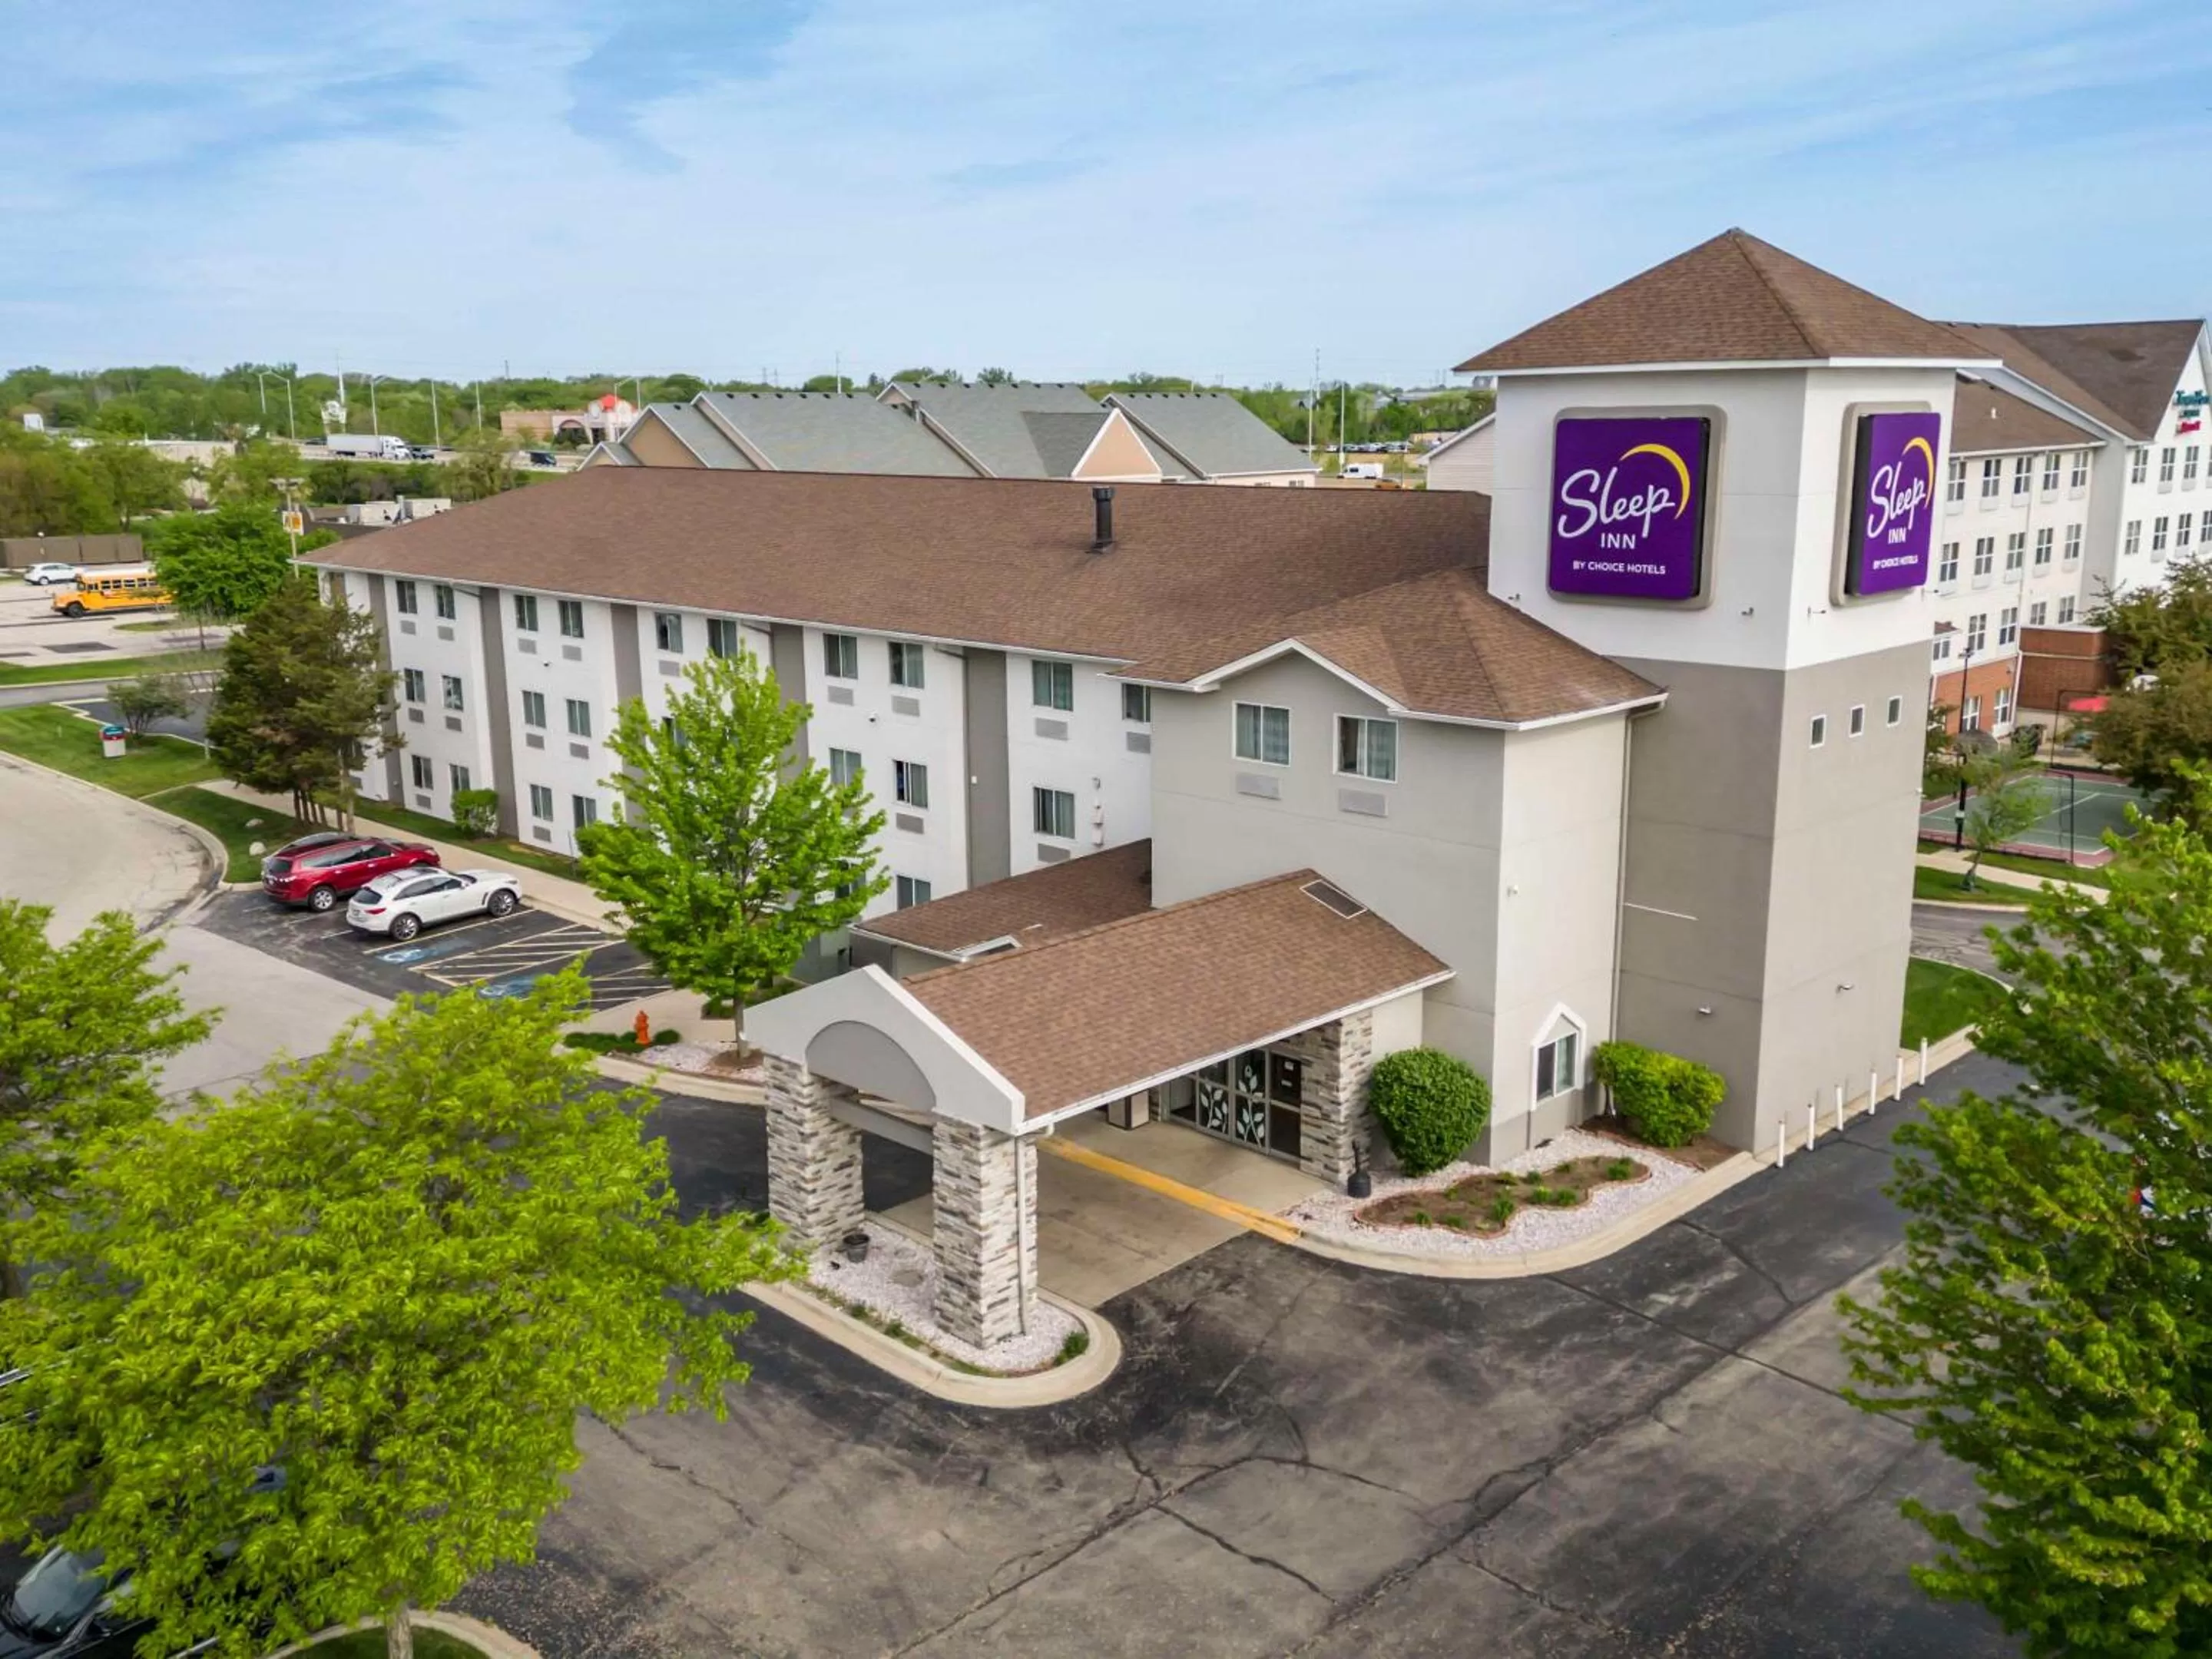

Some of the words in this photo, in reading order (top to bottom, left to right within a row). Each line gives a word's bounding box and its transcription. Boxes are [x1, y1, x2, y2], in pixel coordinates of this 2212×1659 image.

[1558, 466, 1676, 538] Sleep
[1867, 461, 1926, 538] Sleep
[1601, 532, 1637, 550] INN
[1888, 526, 1907, 545] INN
[1573, 560, 1586, 570] BY
[1588, 561, 1625, 572] CHOICE
[1627, 563, 1666, 575] HOTELS
